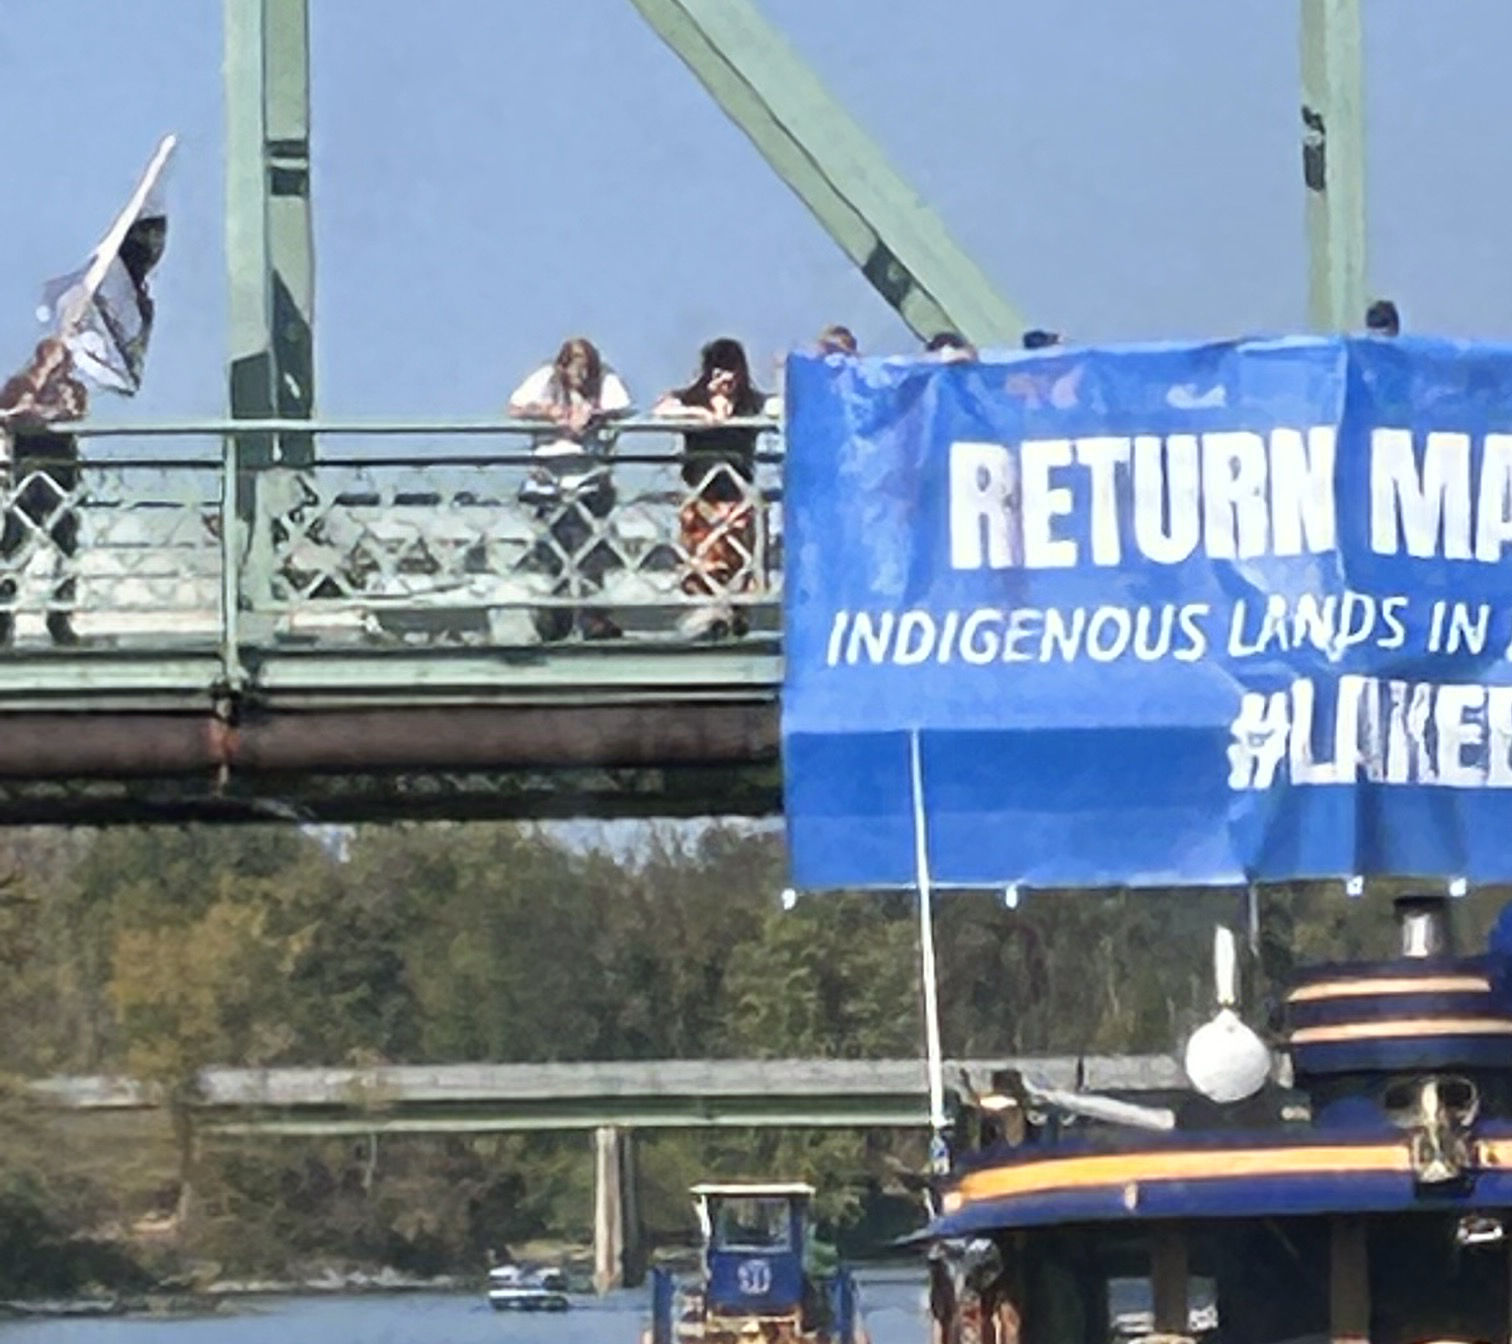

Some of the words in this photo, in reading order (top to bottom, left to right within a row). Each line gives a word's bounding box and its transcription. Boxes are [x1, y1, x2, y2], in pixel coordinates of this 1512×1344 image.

[949, 426, 1338, 571] RETURN
[827, 603, 1208, 665] INDIGENOUS
[1226, 594, 1409, 662] LANDS
[1427, 600, 1489, 656] IN
